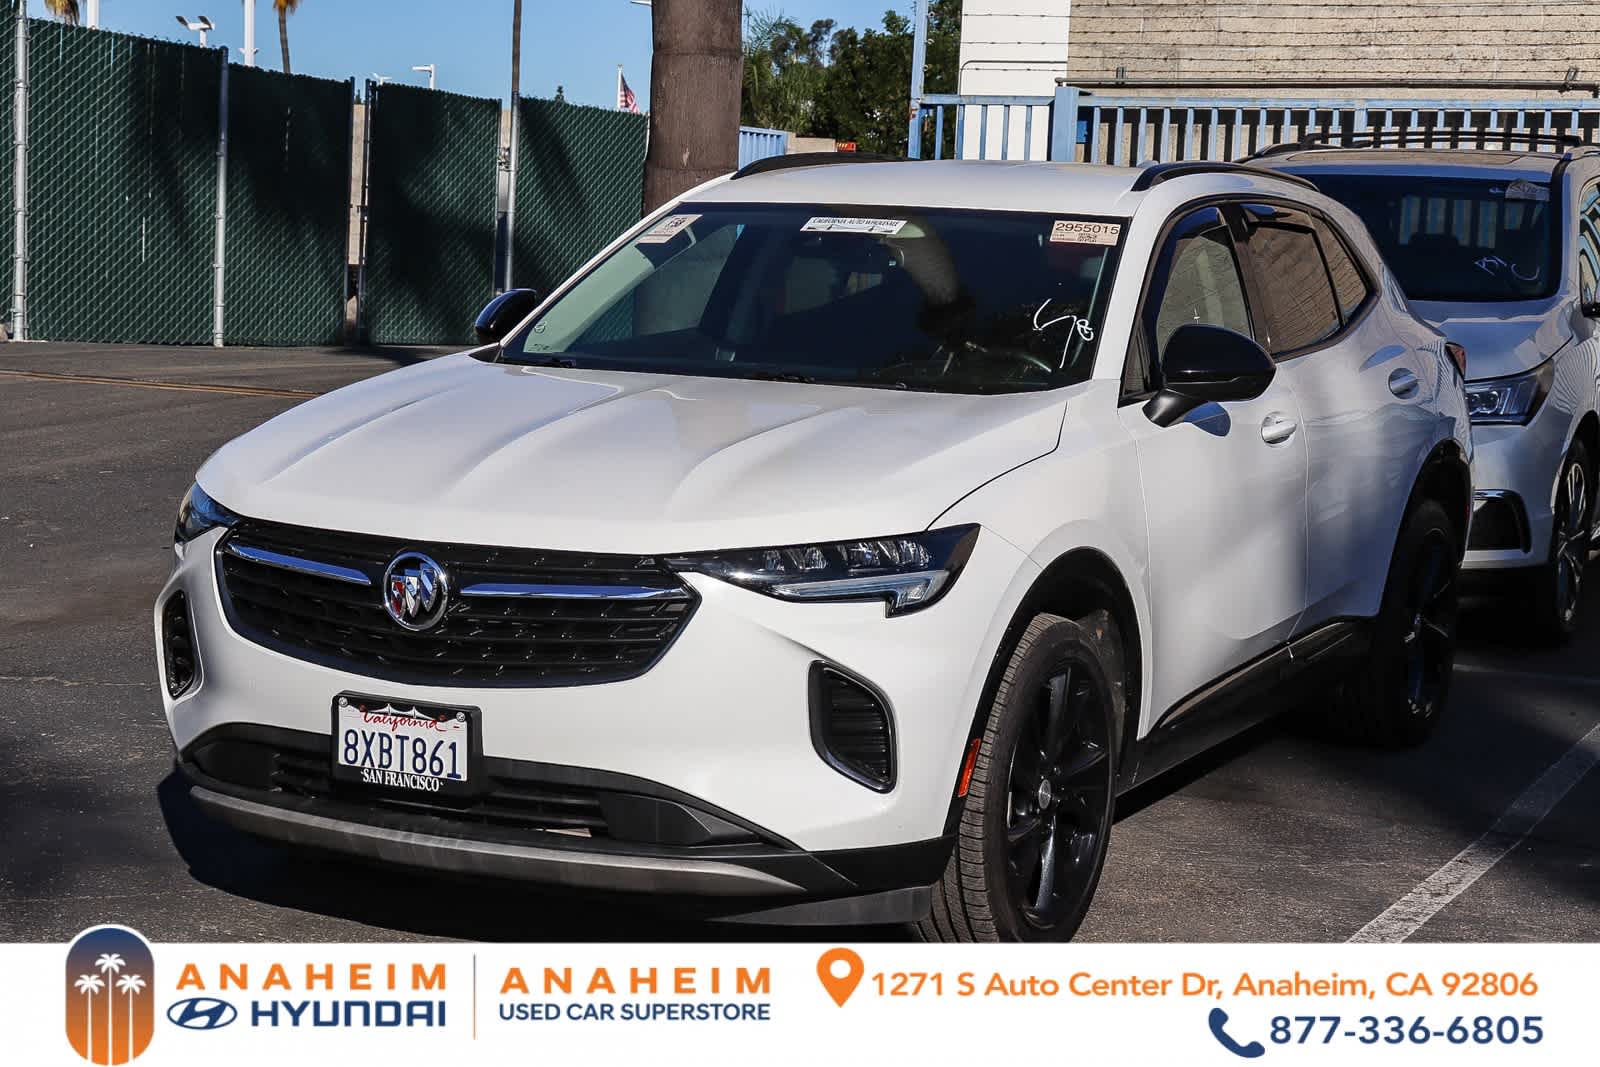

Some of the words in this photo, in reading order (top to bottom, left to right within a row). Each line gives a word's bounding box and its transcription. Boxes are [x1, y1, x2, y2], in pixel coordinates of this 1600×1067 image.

[1055, 222, 1120, 235] 2955015
[343, 728, 462, 781] 8XBT861
[362, 768, 383, 785] SAN
[385, 771, 441, 792] FRANCISCO
